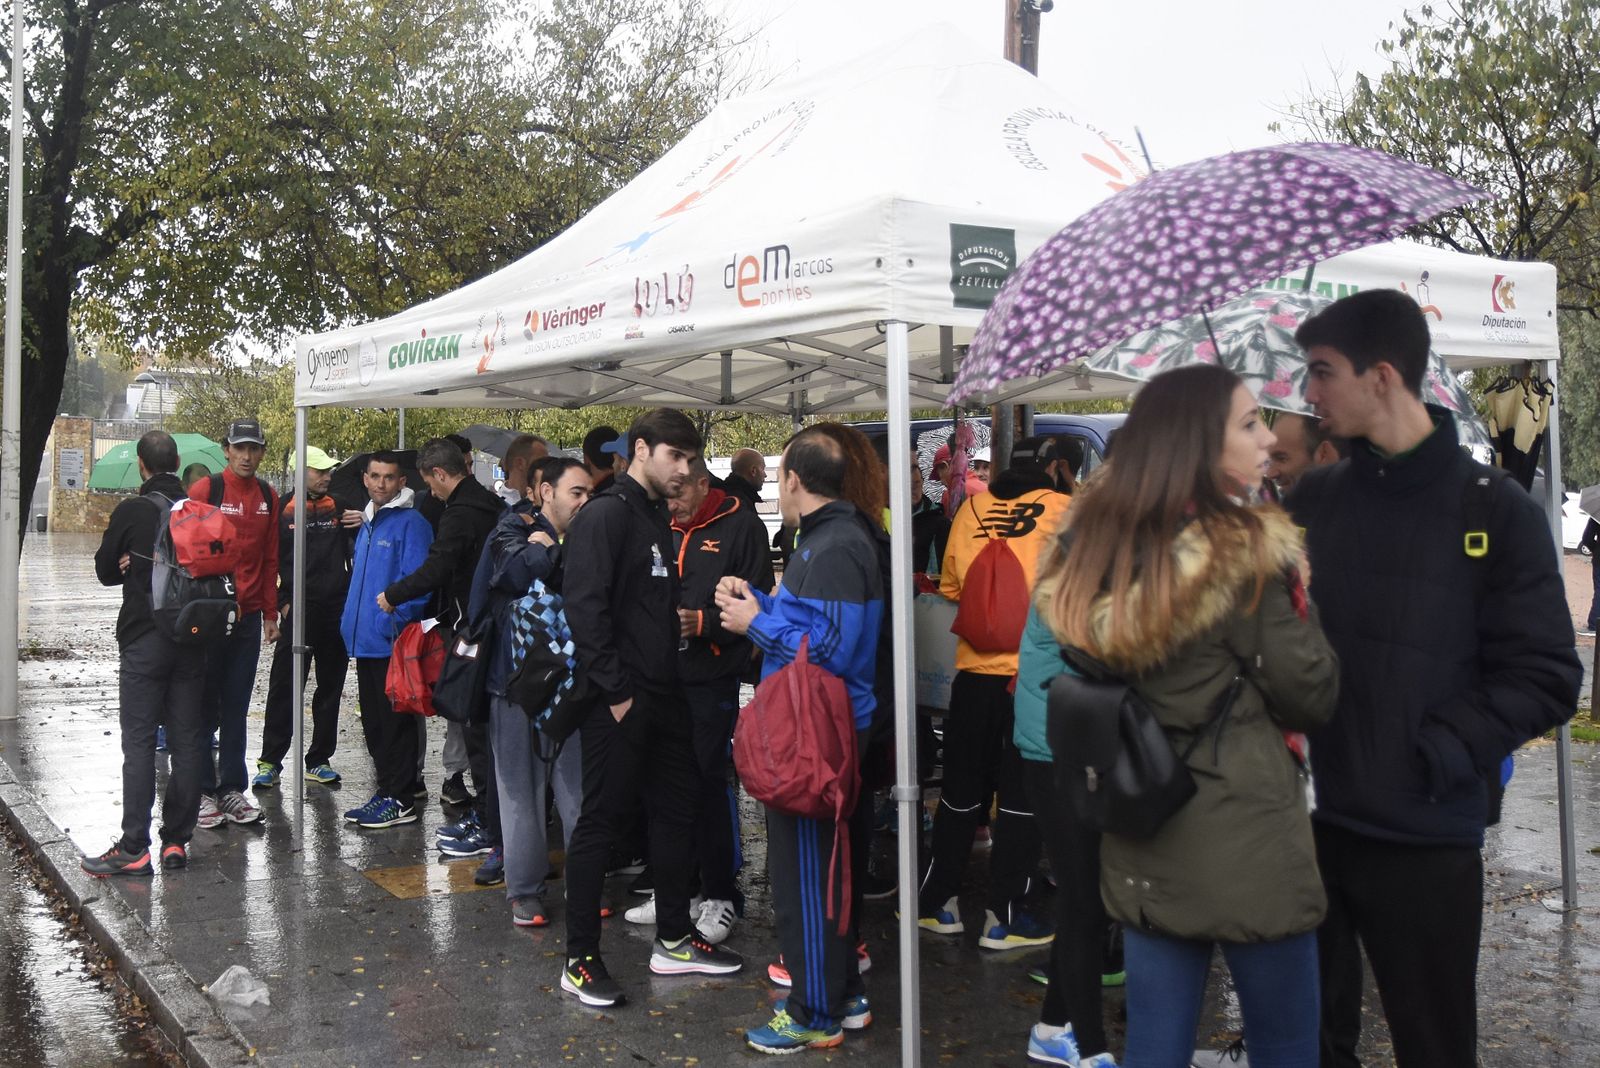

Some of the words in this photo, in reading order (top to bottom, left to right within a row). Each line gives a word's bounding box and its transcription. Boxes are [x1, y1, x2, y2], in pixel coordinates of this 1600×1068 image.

[958, 246, 1010, 263] DIPUTACION
[542, 301, 606, 331] Vèringer
[1482, 314, 1527, 329] Diputación
